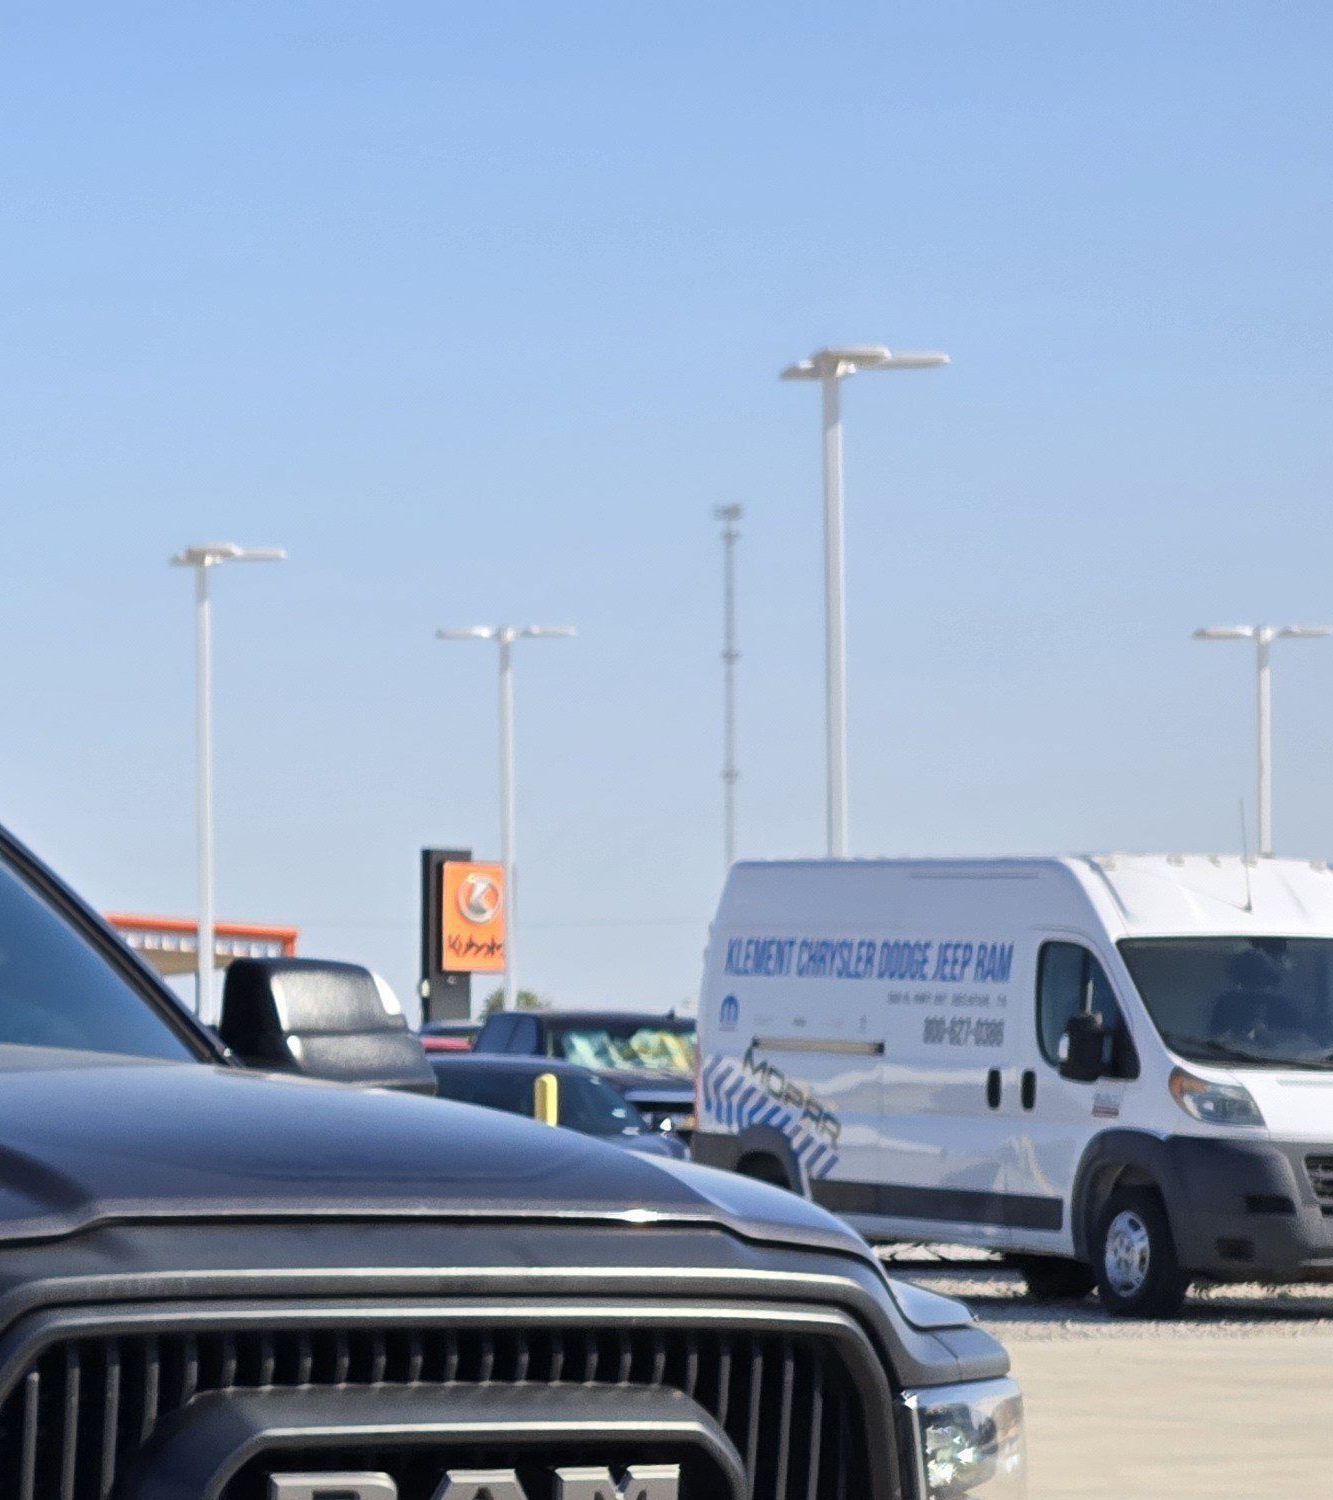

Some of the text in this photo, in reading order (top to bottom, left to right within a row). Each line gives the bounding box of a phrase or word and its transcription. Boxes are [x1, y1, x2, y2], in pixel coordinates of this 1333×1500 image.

[725, 937, 1015, 983] KLEMENT CHRYSLER DODGE JEEP RAM
[743, 1044, 842, 1149] MOPAR
